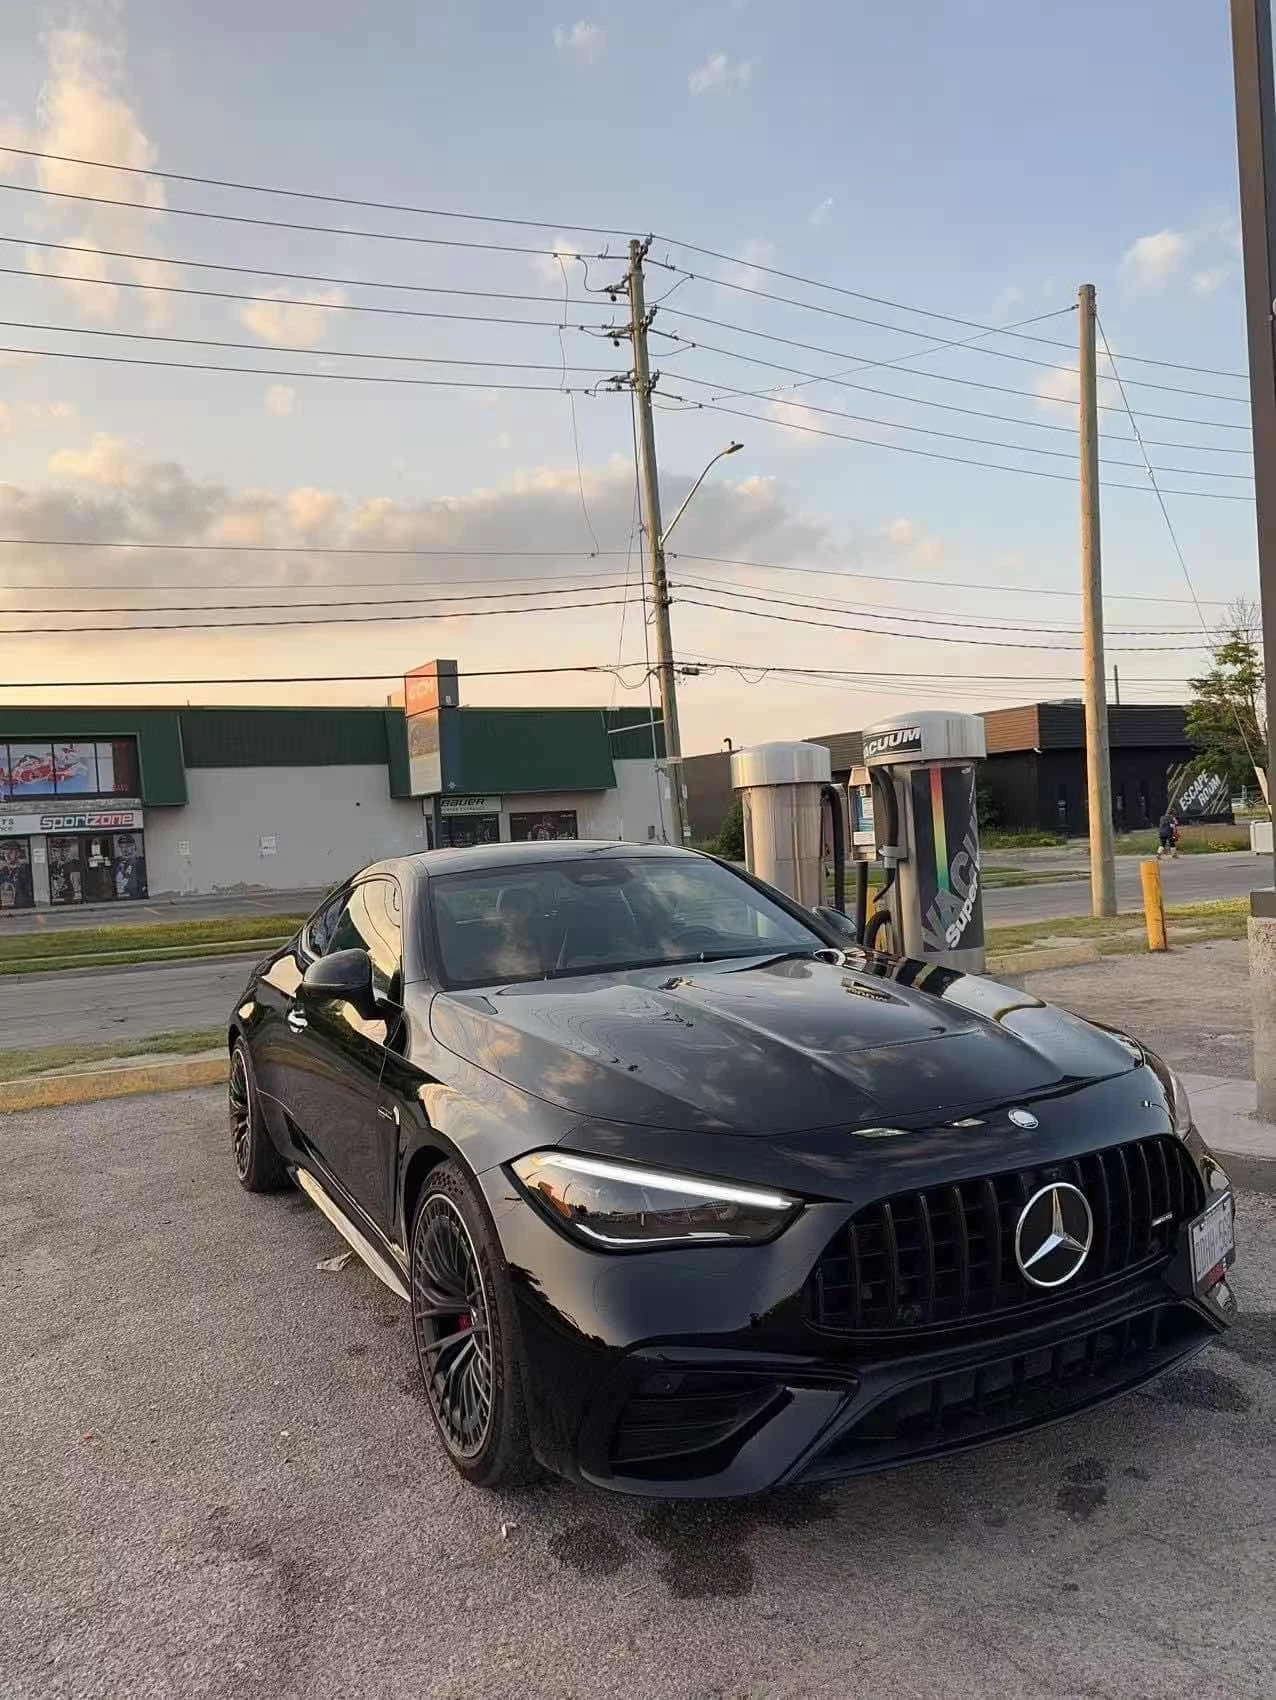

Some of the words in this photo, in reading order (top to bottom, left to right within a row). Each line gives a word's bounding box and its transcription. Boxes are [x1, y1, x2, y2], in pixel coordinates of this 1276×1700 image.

[863, 728, 921, 756] ACUUM
[1180, 769, 1208, 811] ESCAPE
[1198, 774, 1221, 807] ROOM
